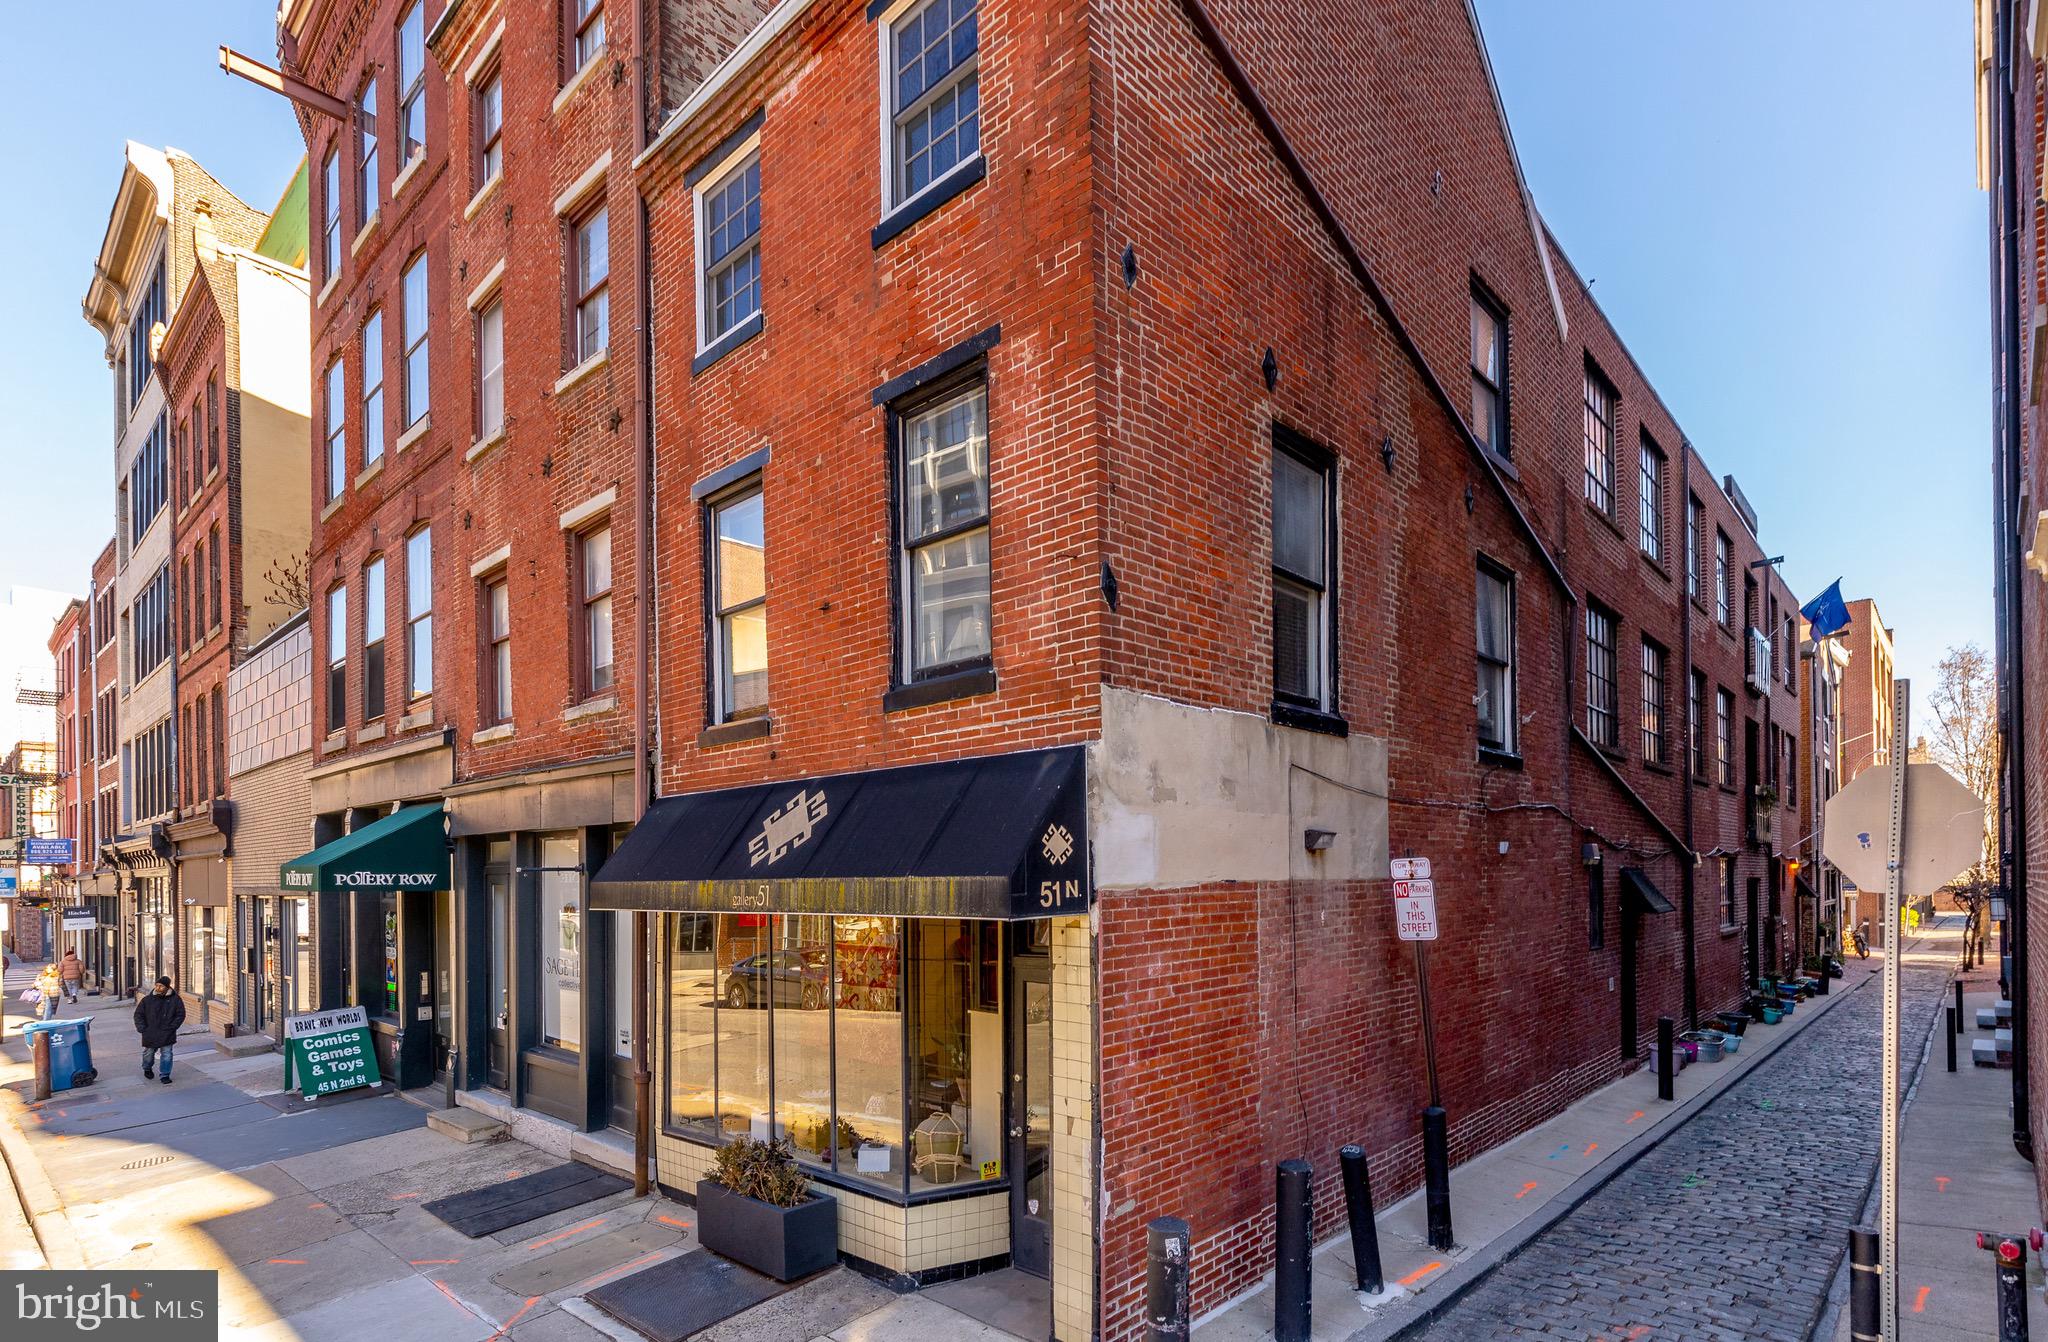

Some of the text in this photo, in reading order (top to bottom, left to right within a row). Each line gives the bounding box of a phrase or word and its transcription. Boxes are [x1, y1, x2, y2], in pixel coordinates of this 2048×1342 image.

[399, 873, 437, 886] ROW
[1040, 881, 1061, 908] 51
[1396, 883, 1430, 897] NO PARKING
[1410, 901, 1419, 910] IN
[1406, 911, 1426, 921] THIS
[1401, 922, 1432, 933] STREET
[545, 957, 568, 976] SAGE
[295, 1012, 361, 1032] BRAVE NEW WORLDS
[303, 1032, 360, 1050] Comics
[308, 1046, 361, 1063] Games
[312, 1058, 364, 1076] & Toys
[318, 1074, 366, 1092] 45 N 2nd St
